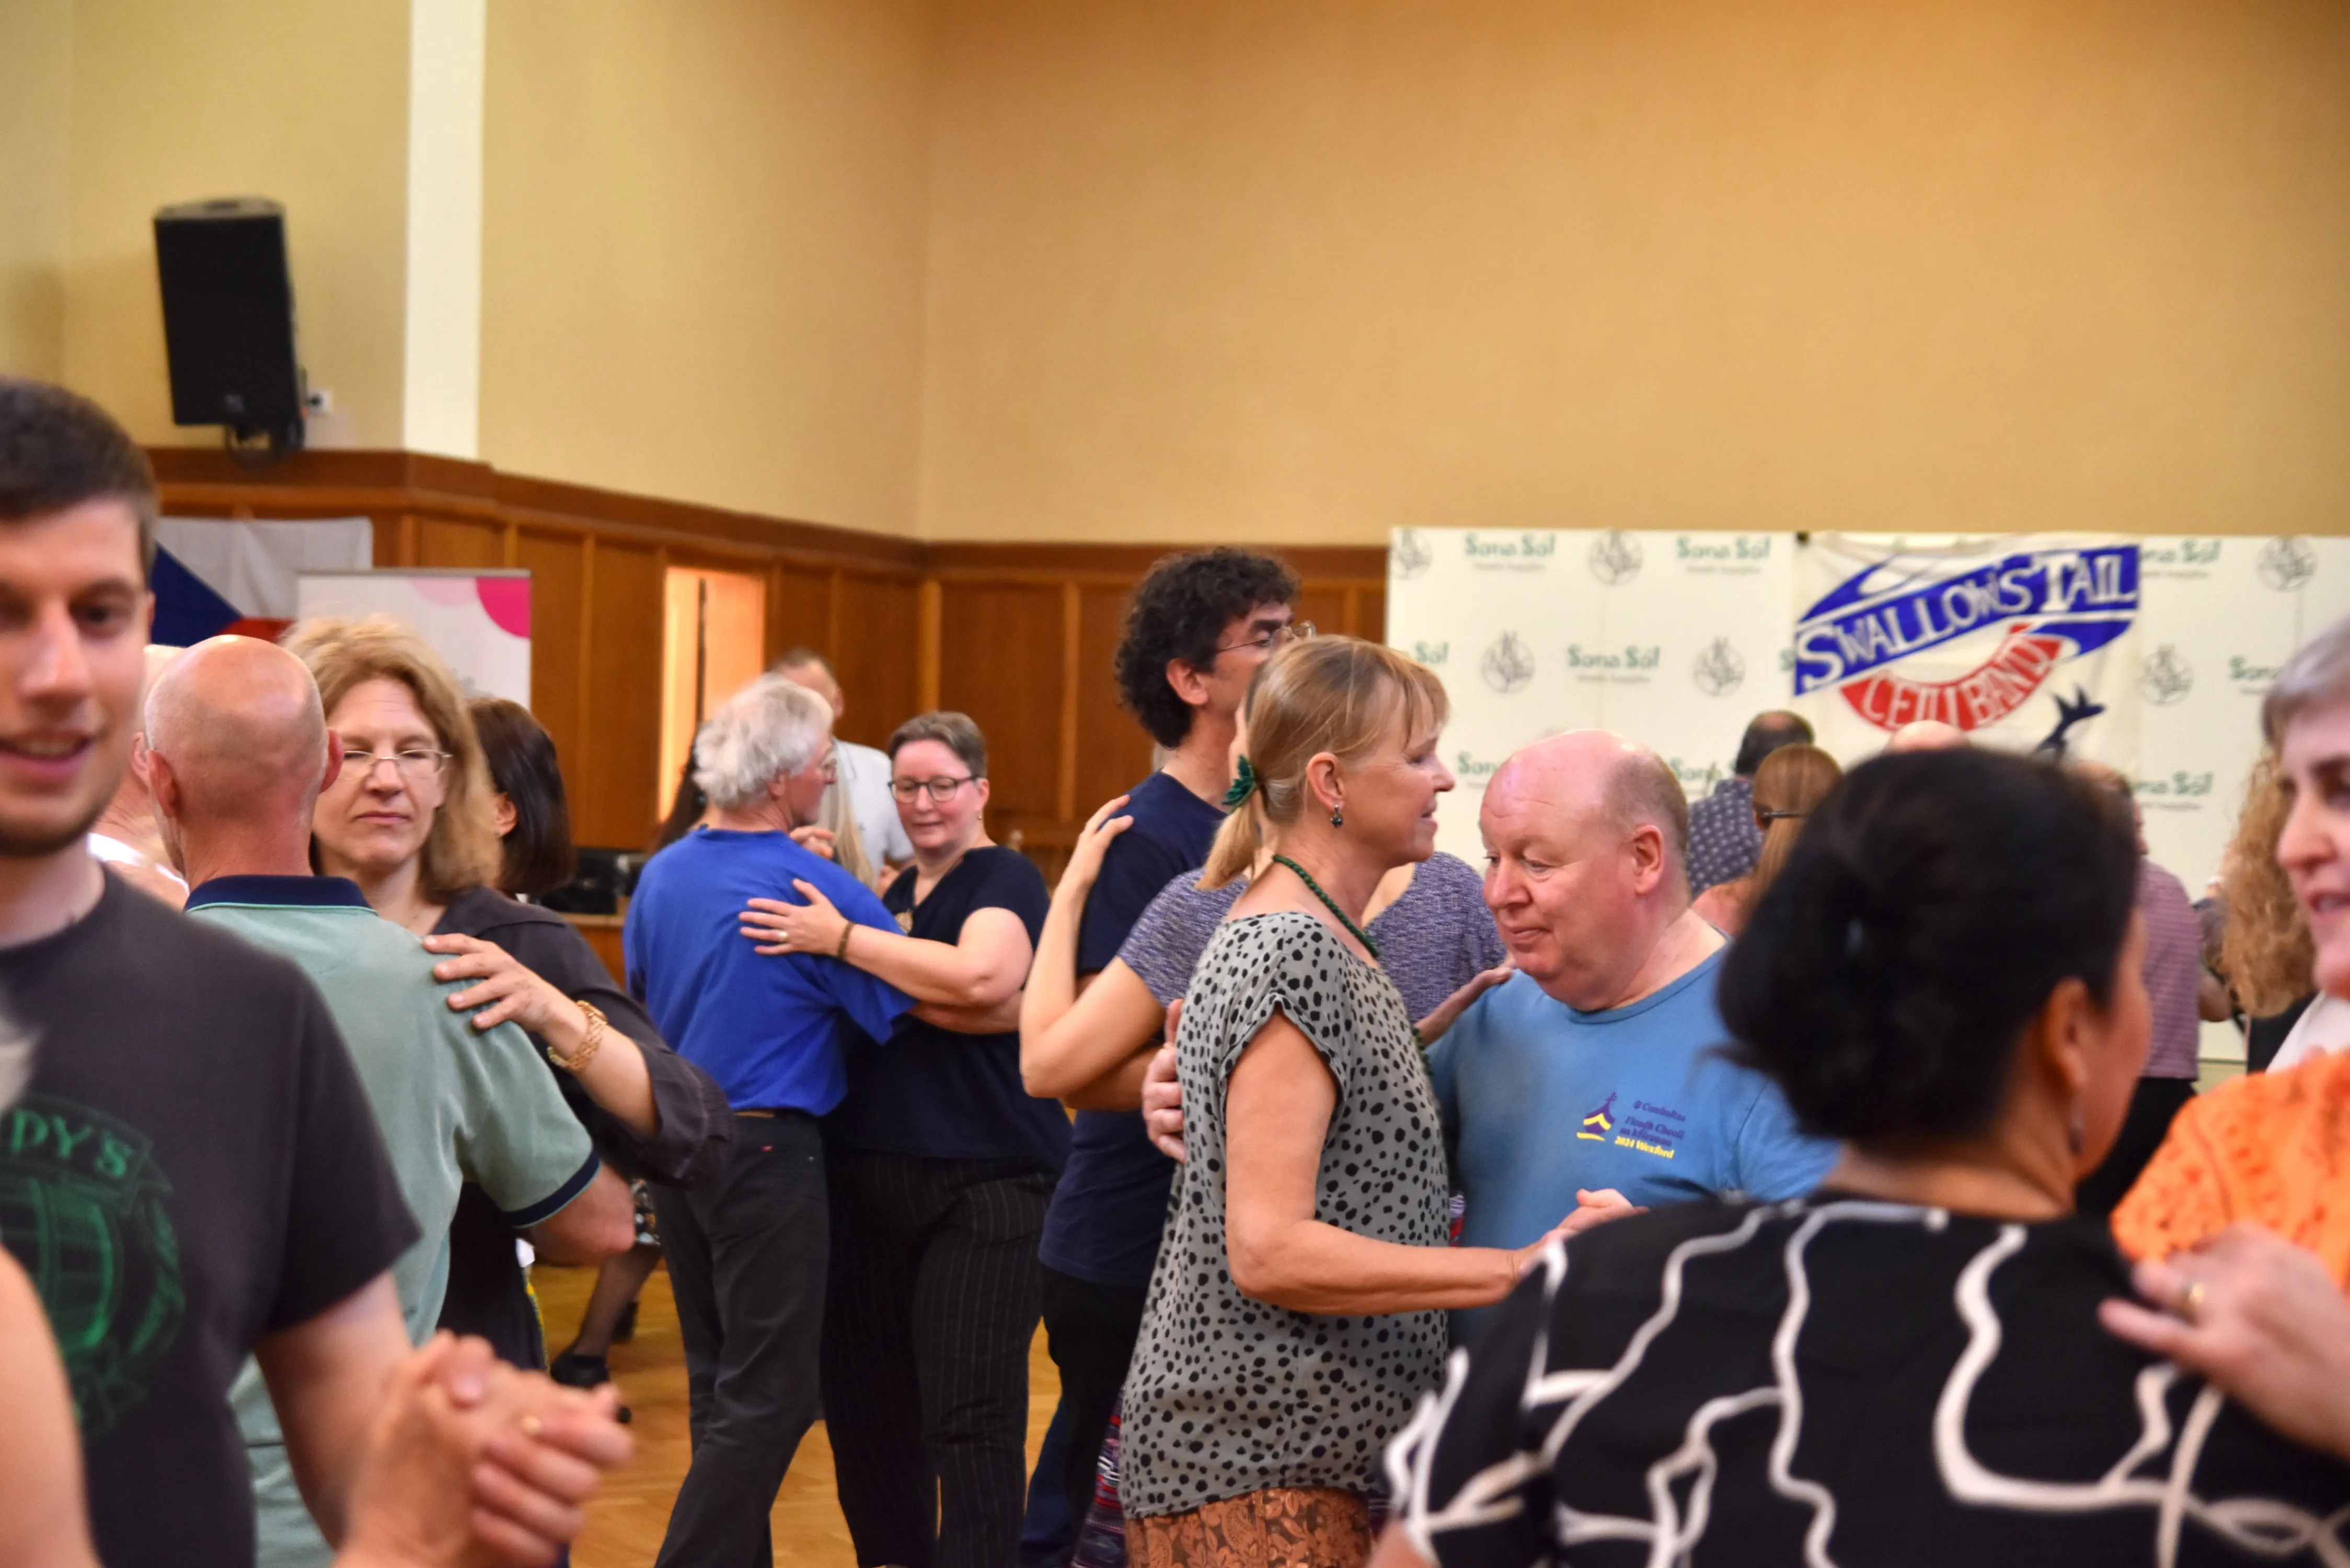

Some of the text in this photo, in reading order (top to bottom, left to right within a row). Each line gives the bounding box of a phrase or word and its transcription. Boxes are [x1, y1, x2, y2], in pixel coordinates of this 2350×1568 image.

[1465, 533, 1517, 557] Sona
[1677, 536, 1731, 559] Sona
[2031, 552, 2138, 612] TAIL
[1568, 644, 1620, 668] Sona
